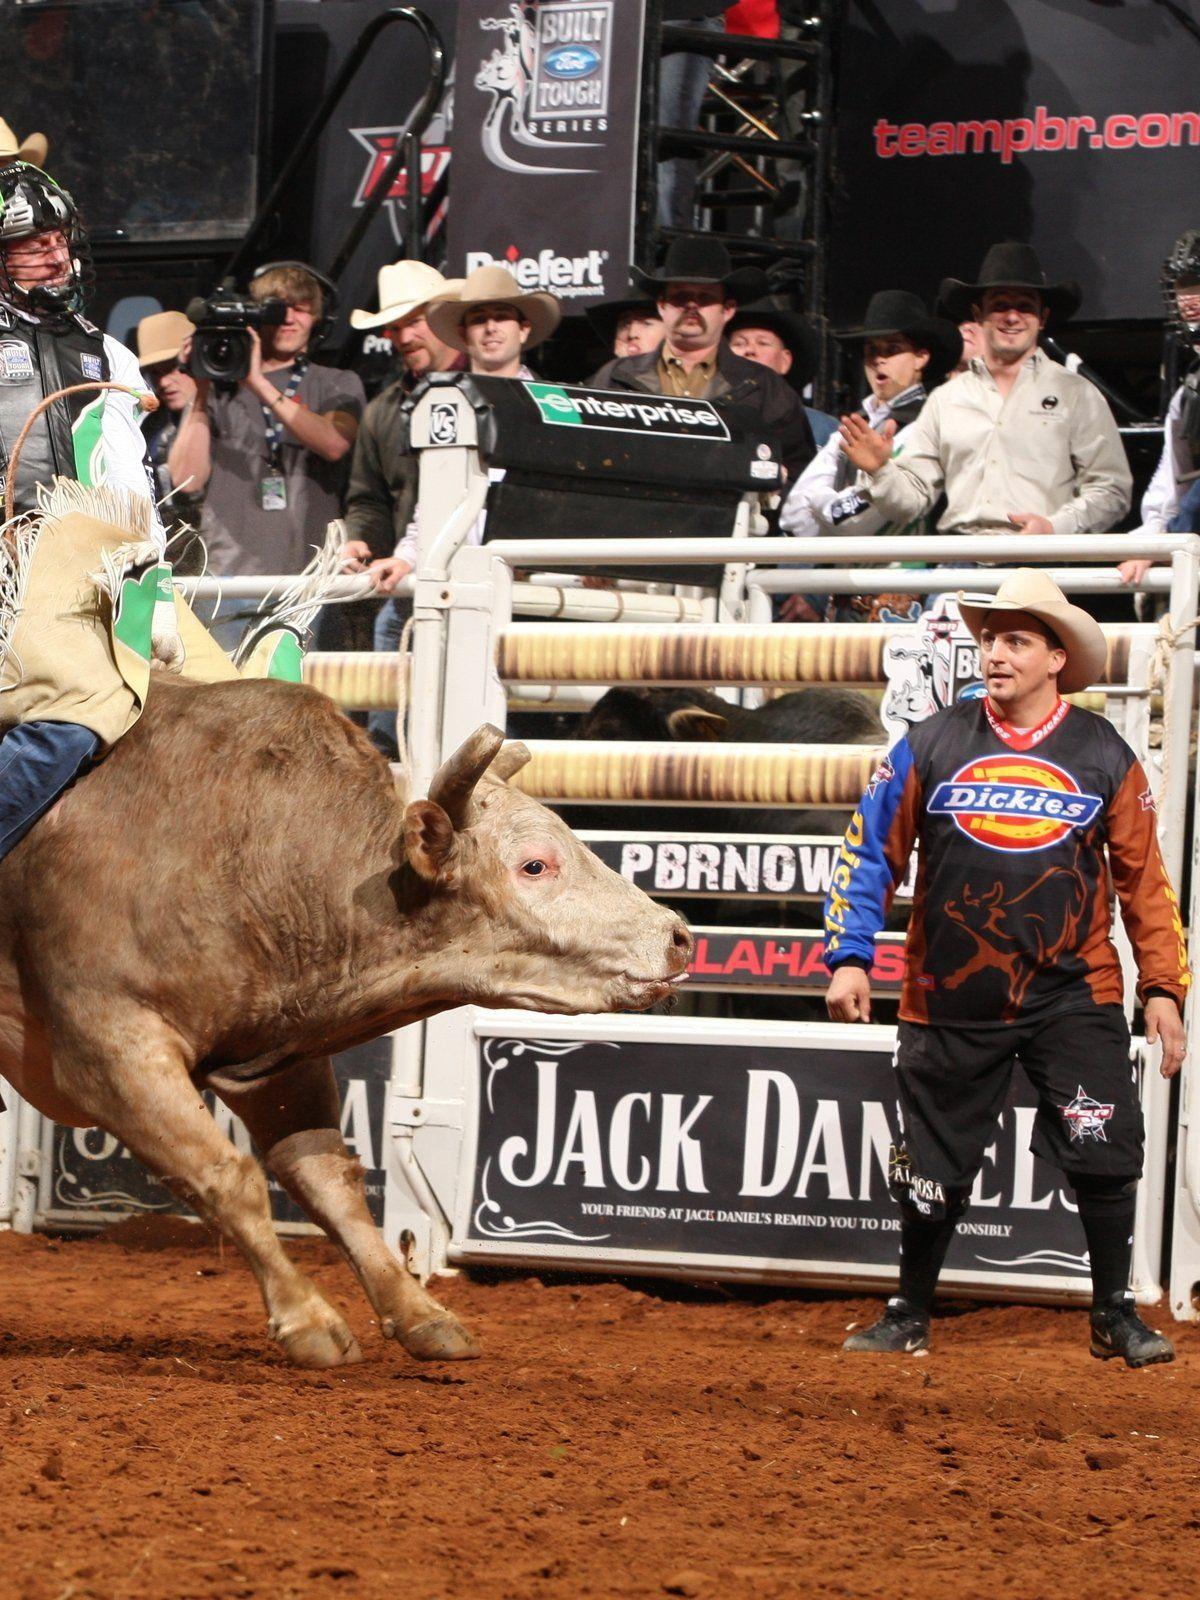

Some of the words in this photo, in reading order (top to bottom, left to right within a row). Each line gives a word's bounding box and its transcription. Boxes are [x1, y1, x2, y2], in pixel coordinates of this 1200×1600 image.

[541, 11, 606, 43] BUILT
[539, 80, 602, 107] TOUGH
[527, 119, 608, 134] SERIES
[873, 106, 1200, 164] teampbr.com
[537, 394, 720, 427] enterprise
[943, 786, 1085, 818] Dickies
[499, 1060, 715, 1194] JACK
[581, 1202, 614, 1216] YOUR
[616, 1204, 667, 1219] FRIENDS
[668, 1207, 684, 1219] AT
[684, 1208, 716, 1222] JACK
[717, 1210, 772, 1225] DANIEL'S
[774, 1213, 827, 1227] REMIND
[829, 1215, 858, 1229] YOU
[859, 1217, 878, 1230] TO
[955, 1223, 1013, 1238] ONSIBLY
